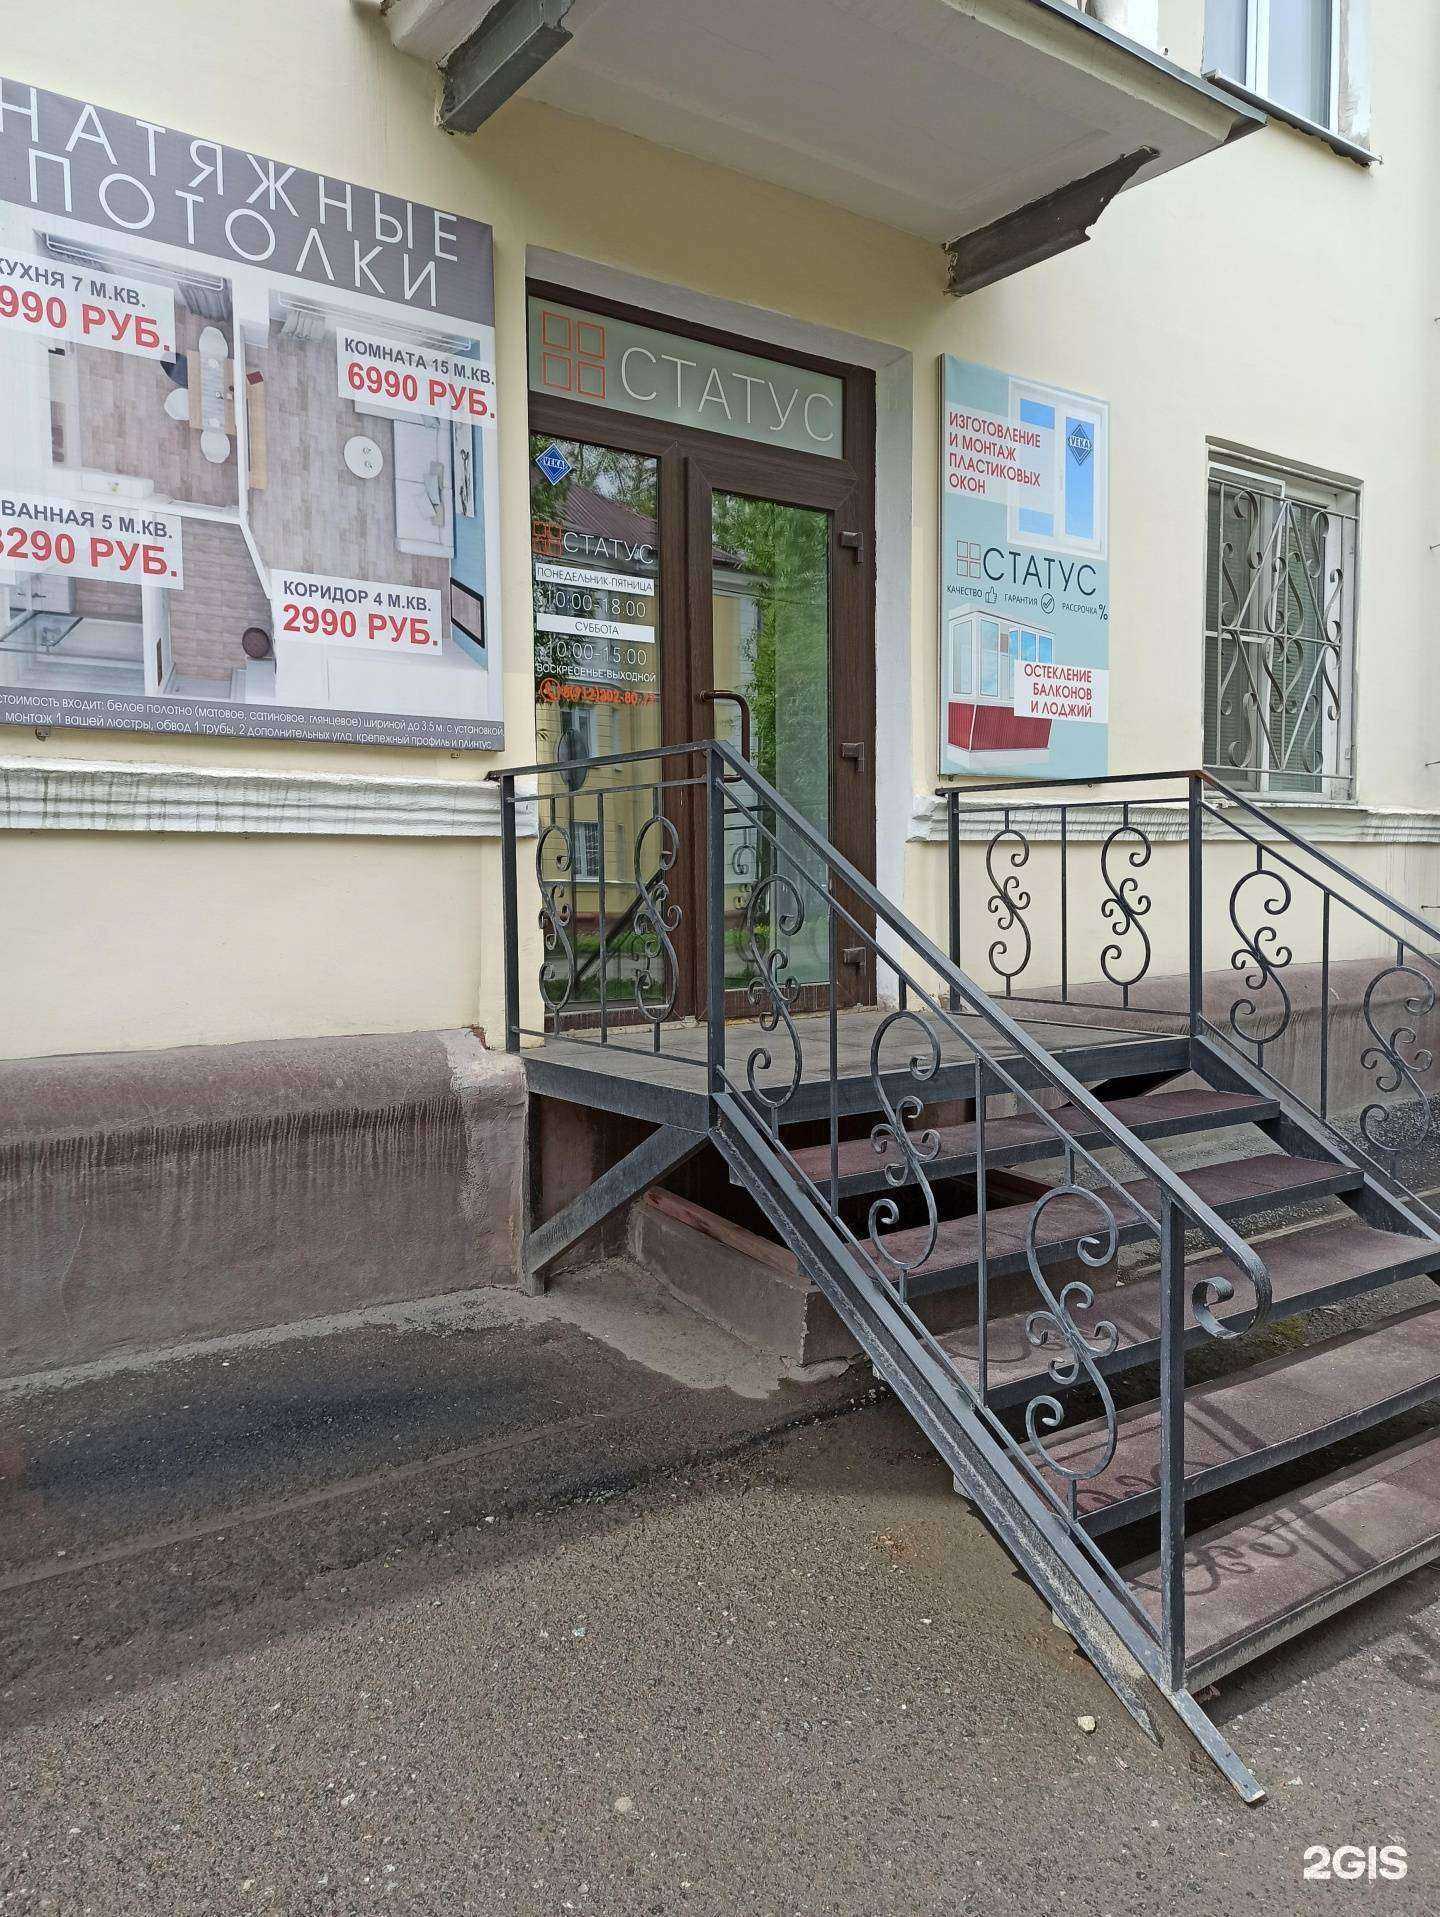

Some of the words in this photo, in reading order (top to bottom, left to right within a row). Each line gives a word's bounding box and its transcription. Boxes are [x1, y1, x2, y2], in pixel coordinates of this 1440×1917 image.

[0, 79, 458, 262] НАТЯЖНЫЕ
[28, 148, 437, 307] ПОТОЛКИ
[72, 276, 83, 292] 7
[90, 281, 146, 308] М.КВ.
[0, 285, 67, 329] 990
[82, 304, 170, 351] РУБ.
[345, 338, 427, 370] КОМНАТА
[432, 358, 449, 374] 15
[454, 363, 495, 385] М.КВ.
[348, 362, 418, 401] 6990
[429, 379, 495, 418] РУБ.
[621, 347, 834, 441] СТАТУС
[950, 411, 1041, 448] ИЗГОТОВЛЕНИЕ
[1070, 437, 1089, 450] VEKA
[950, 432, 958, 447] И
[962, 435, 1016, 461] МОНТАЖ
[949, 453, 1041, 487] ПЛАСТИКОВЫХ
[949, 473, 986, 494] ОКОН
[1, 500, 94, 528] ВАННАЯ
[102, 515, 112, 530] 5
[119, 517, 173, 538] М.КВ.
[0, 527, 75, 564] 290
[90, 538, 177, 577] РУБ.
[564, 531, 653, 564] СТАТУС
[983, 547, 1096, 596] СТАТУС
[283, 581, 368, 605] КОРИДОР
[373, 593, 383, 606] 4
[388, 594, 431, 611] М.КВ.
[947, 585, 982, 598] КАЧЕСТВО
[1004, 594, 1038, 606] ГАРАНТИЯ
[1062, 602, 1097, 614] РАССРОЧКА
[283, 604, 356, 638] 2990
[368, 613, 438, 646] РУБ.
[575, 622, 619, 635] СУББОТА
[1024, 663, 1092, 683] ОСТЕКЛЕНИЕ
[1033, 683, 1092, 701] БАЛКОНОВ
[63, 699, 104, 711] входит:
[107, 699, 144, 713] белое
[147, 704, 192, 717] полотно
[364, 718, 405, 731] шириной
[408, 722, 420, 732] до
[1031, 700, 1038, 714] И
[1042, 701, 1092, 718] ЛОДЖИЙ
[5, 712, 52, 724] монтаж
[56, 713, 61, 724] 1
[66, 714, 104, 726] вашей
[157, 720, 191, 733] обвод
[195, 722, 199, 732] 1
[239, 724, 246, 735] 2
[248, 727, 329, 740] дополнительных
[356, 732, 410, 744] крепежный
[412, 736, 450, 747] профиль
